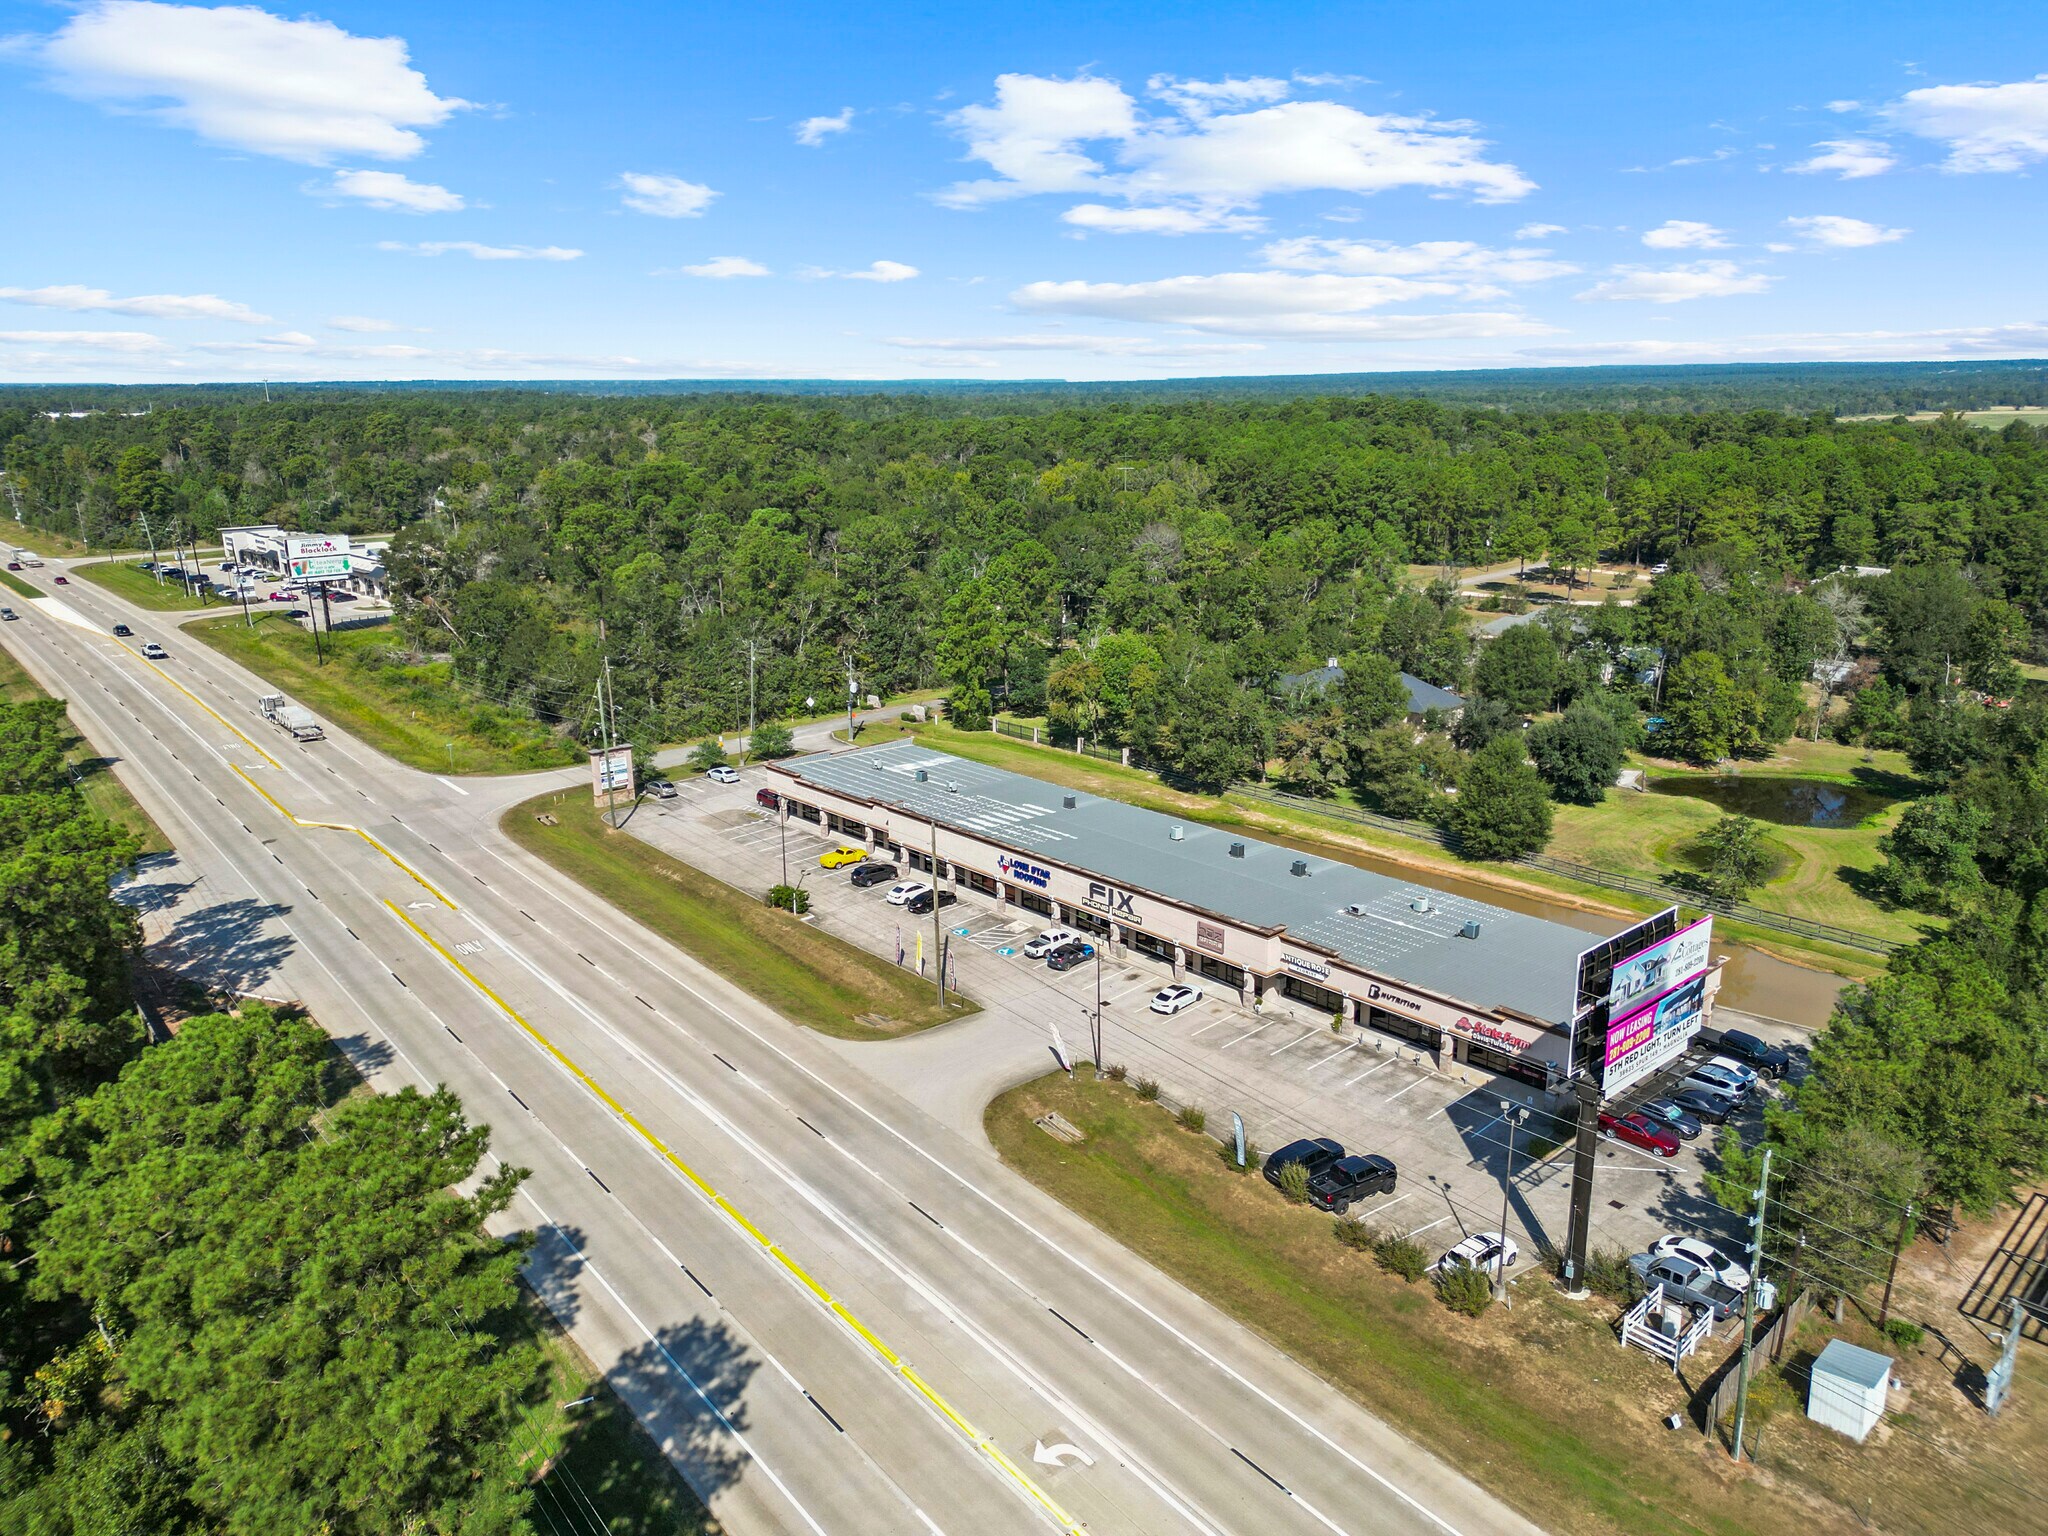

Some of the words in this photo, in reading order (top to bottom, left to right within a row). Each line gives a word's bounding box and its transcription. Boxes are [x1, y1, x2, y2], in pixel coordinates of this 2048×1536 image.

[1010, 858, 1029, 872] LONE
[1031, 865, 1051, 880] STAR
[1013, 869, 1047, 888] ROOFING
[1089, 882, 1134, 915] FIX
[454, 940, 486, 956] ONLY
[1280, 953, 1311, 969] ANTIQUE
[1311, 962, 1331, 976] ROSE
[1380, 992, 1422, 1011] NUTRITION
[1474, 1021, 1501, 1039] State
[1503, 1031, 1531, 1049] Farm
[1609, 1026, 1626, 1047] NOW
[1626, 1011, 1653, 1036] LEASING
[1609, 1026, 1651, 1061] 281-809-2200
[1609, 1060, 1623, 1076] 5TH
[1624, 1051, 1639, 1066] RED
[1640, 1038, 1661, 1056] LIGHT,
[1663, 1025, 1681, 1042] TURN
[1682, 1015, 1699, 1031] LEFT
[1636, 1056, 1648, 1068] SPUR
[1663, 1031, 1688, 1049] MAGNOLIA
